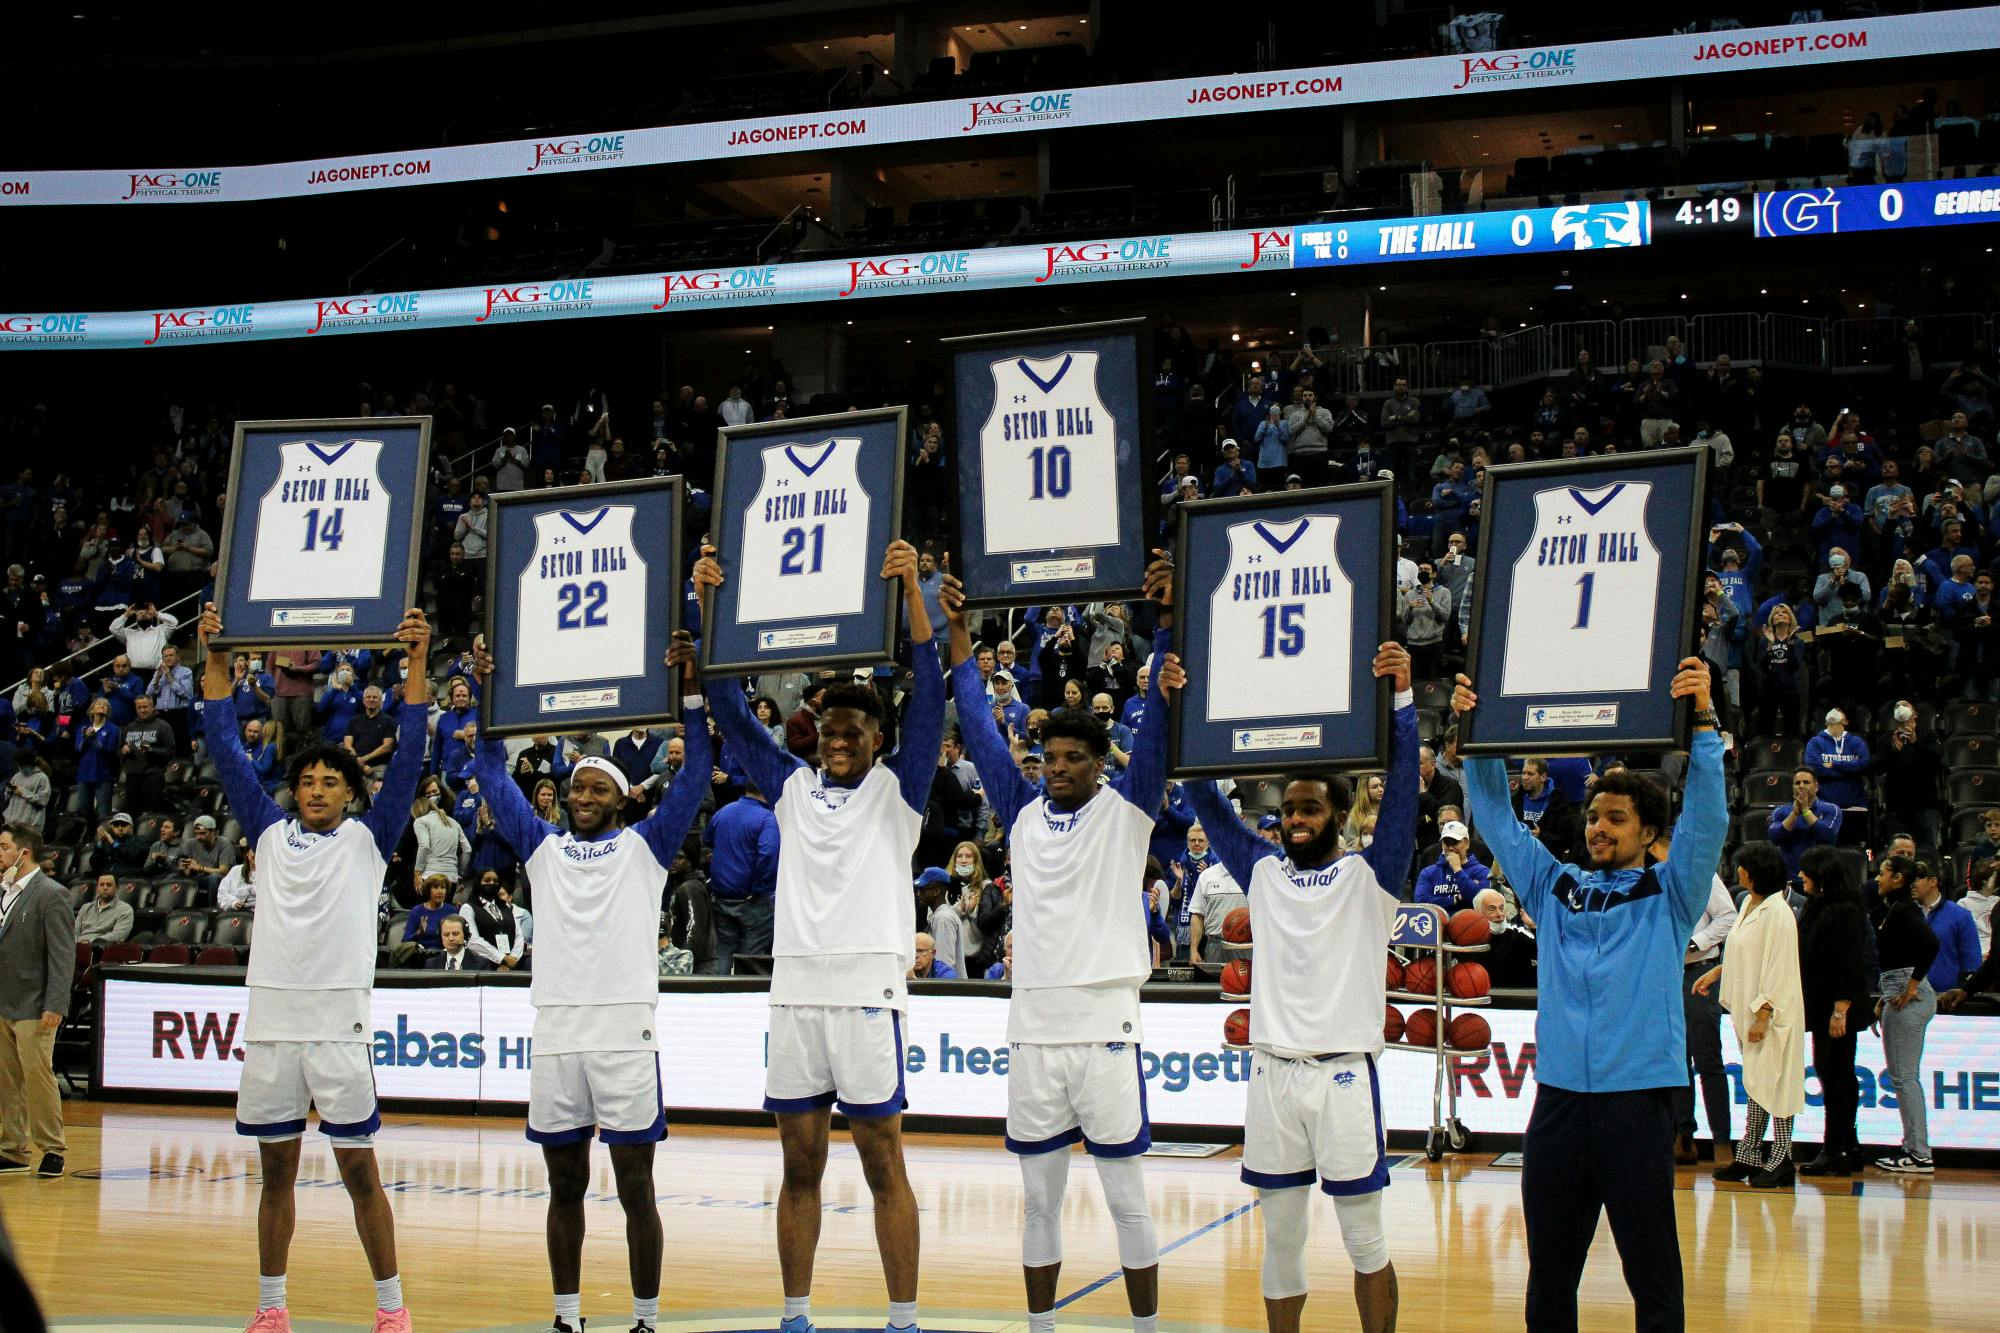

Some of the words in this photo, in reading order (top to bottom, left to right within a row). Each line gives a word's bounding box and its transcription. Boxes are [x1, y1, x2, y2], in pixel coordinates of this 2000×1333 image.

[1694, 32, 1867, 60] JAGONEPT.COM
[1454, 49, 1576, 89] JAG-ONE
[1470, 73, 1523, 84] PHYSICAL
[1525, 68, 1575, 79] THERAPY
[1187, 77, 1342, 104] JAGONEPT.COM
[963, 93, 1071, 131] JAG-ONE
[978, 115, 1024, 126] PHYSICAL
[1026, 111, 1071, 121] THERAPY
[728, 120, 866, 145] JAGONEPT.COM
[527, 136, 624, 172] JAG-ONE
[541, 156, 582, 166] PHYSICAL
[584, 152, 624, 162] THERAPY
[0, 182, 29, 195] OM
[122, 172, 221, 200] JAG-ONE
[308, 160, 431, 185] JAGONEPT.COM
[181, 188, 220, 196] THERAPY
[1879, 188, 1903, 222] 0
[1675, 197, 1740, 224] 4:19
[1338, 230, 1348, 242] 0
[1378, 225, 1418, 255] THE
[1421, 222, 1476, 253] HALL
[1511, 215, 1533, 246] 0
[1035, 237, 1172, 283] JAG-ONE
[1054, 264, 1112, 276] PHYSICAL
[1114, 260, 1172, 272] THERAPY
[1338, 245, 1348, 259] 0
[653, 268, 776, 310] JAG-ONE
[840, 252, 969, 296] JAG-ONE
[857, 279, 913, 290] PHYSICAL
[914, 274, 968, 286] THERAPY
[475, 280, 594, 322] JAG-ONE
[492, 306, 544, 316] PHYSICAL
[546, 302, 592, 312] THERAPY
[670, 293, 723, 304] PHYSICAL
[724, 289, 776, 300] THERAPY
[145, 306, 254, 344] JAG-ONE
[307, 294, 420, 334] JAG-ONE
[323, 318, 372, 328] PHYSICAL
[373, 314, 418, 324] THERAPY
[160, 330, 207, 338] PHYSICAL
[208, 326, 254, 336] THERAPY
[1004, 410, 1047, 441] SETON
[1056, 407, 1094, 437] HALL
[1027, 444, 1072, 500] 10
[282, 479, 326, 503] SETON
[334, 478, 370, 501] HALL
[765, 492, 806, 523] SETON
[814, 488, 847, 516] HALL
[300, 508, 344, 552] 14
[540, 550, 582, 580] SETON
[592, 546, 626, 573] HALL
[780, 523, 826, 576] 21
[1538, 533, 1588, 566] SETON
[1598, 532, 1638, 562] HALL
[1234, 570, 1280, 602] SETON
[1292, 566, 1331, 596] HALL
[557, 580, 608, 632] 22
[1570, 572, 1596, 630] 1
[1258, 602, 1306, 660] 15
